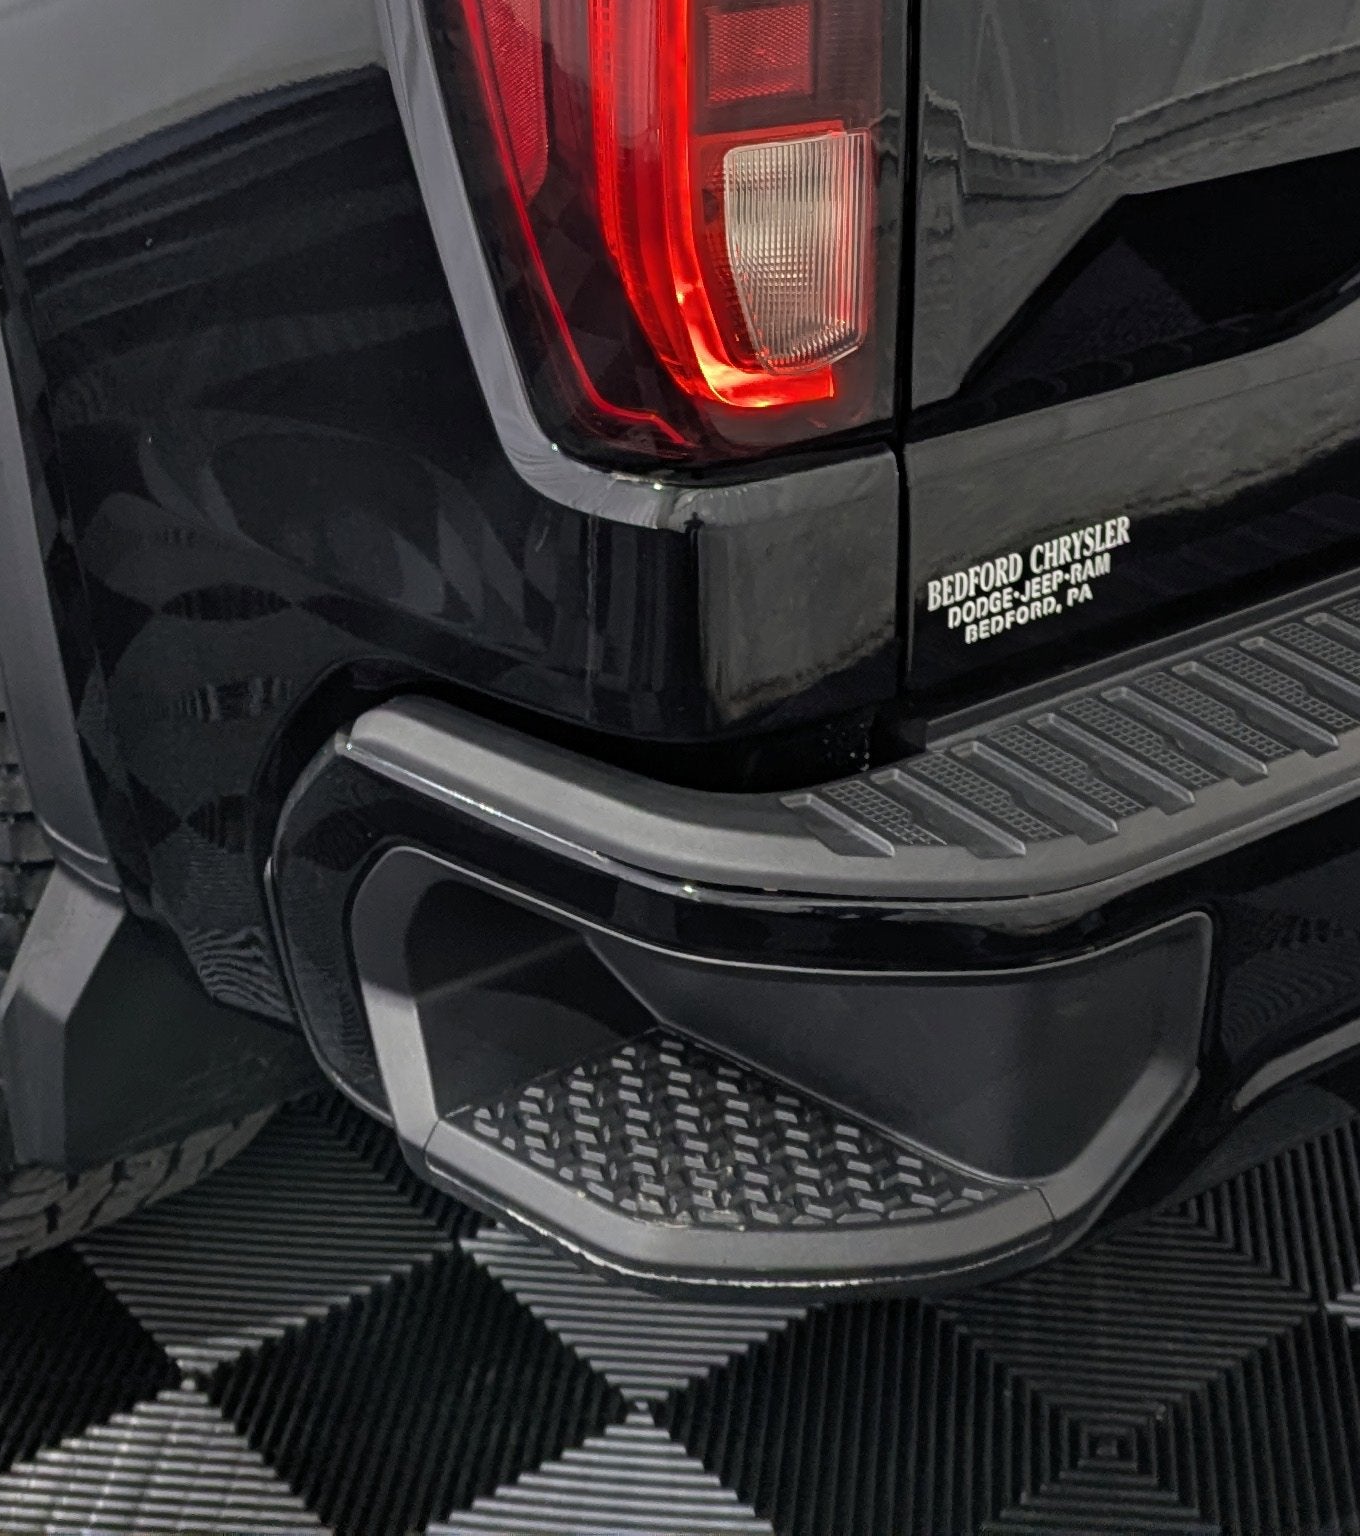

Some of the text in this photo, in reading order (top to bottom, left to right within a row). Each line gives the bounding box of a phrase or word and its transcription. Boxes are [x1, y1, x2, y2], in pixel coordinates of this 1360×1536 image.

[927, 515, 1131, 612] BEDFORD CHRYSLER
[965, 582, 1093, 645] BEDFORD, PA
